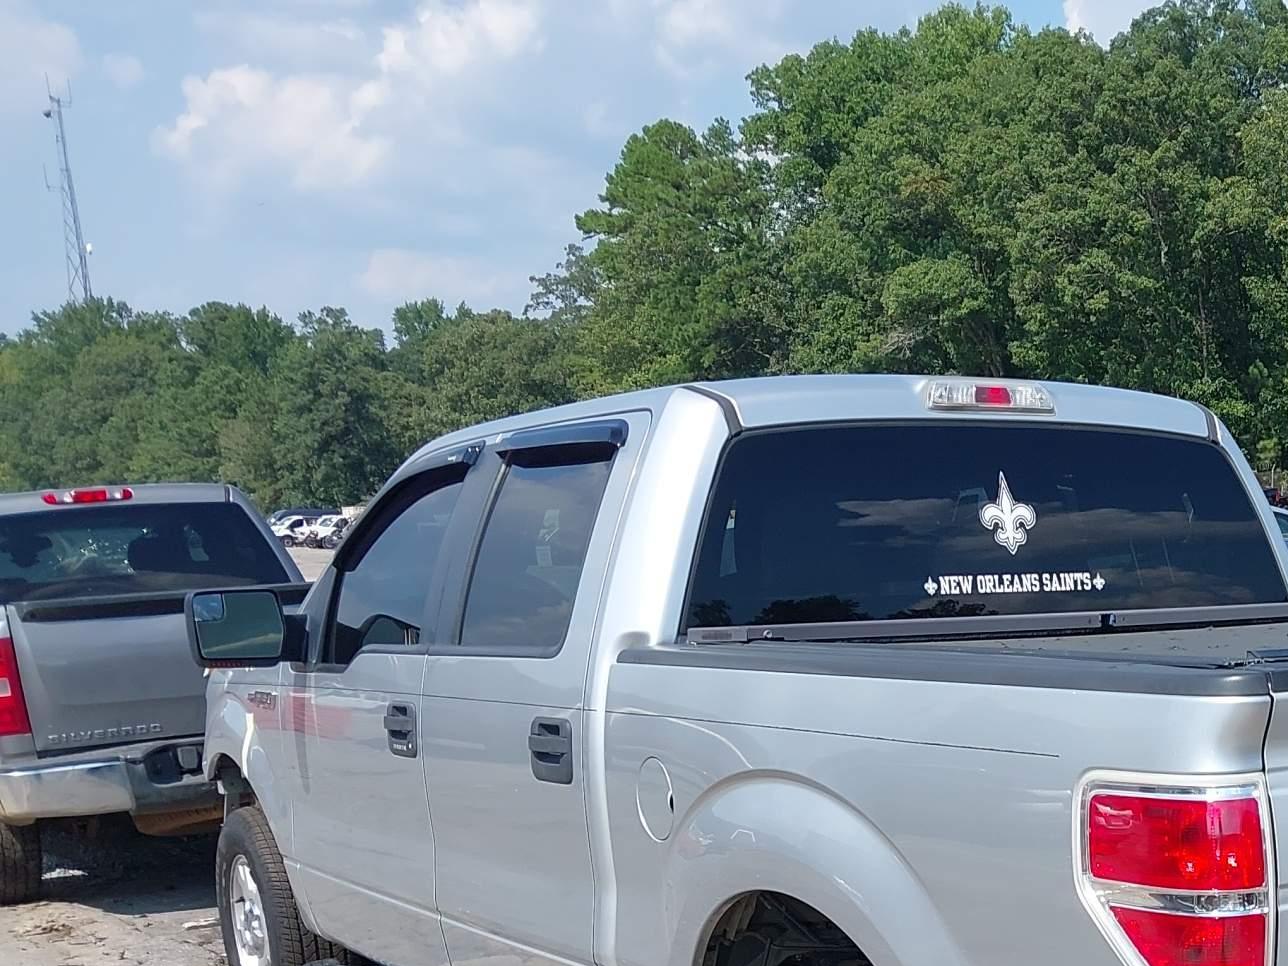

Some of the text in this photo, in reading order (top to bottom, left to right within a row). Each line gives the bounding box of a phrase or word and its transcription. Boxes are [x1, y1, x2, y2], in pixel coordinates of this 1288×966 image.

[938, 572, 1092, 595] NEW ORLEANS SAINTS
[47, 723, 162, 743] SILVERADO
